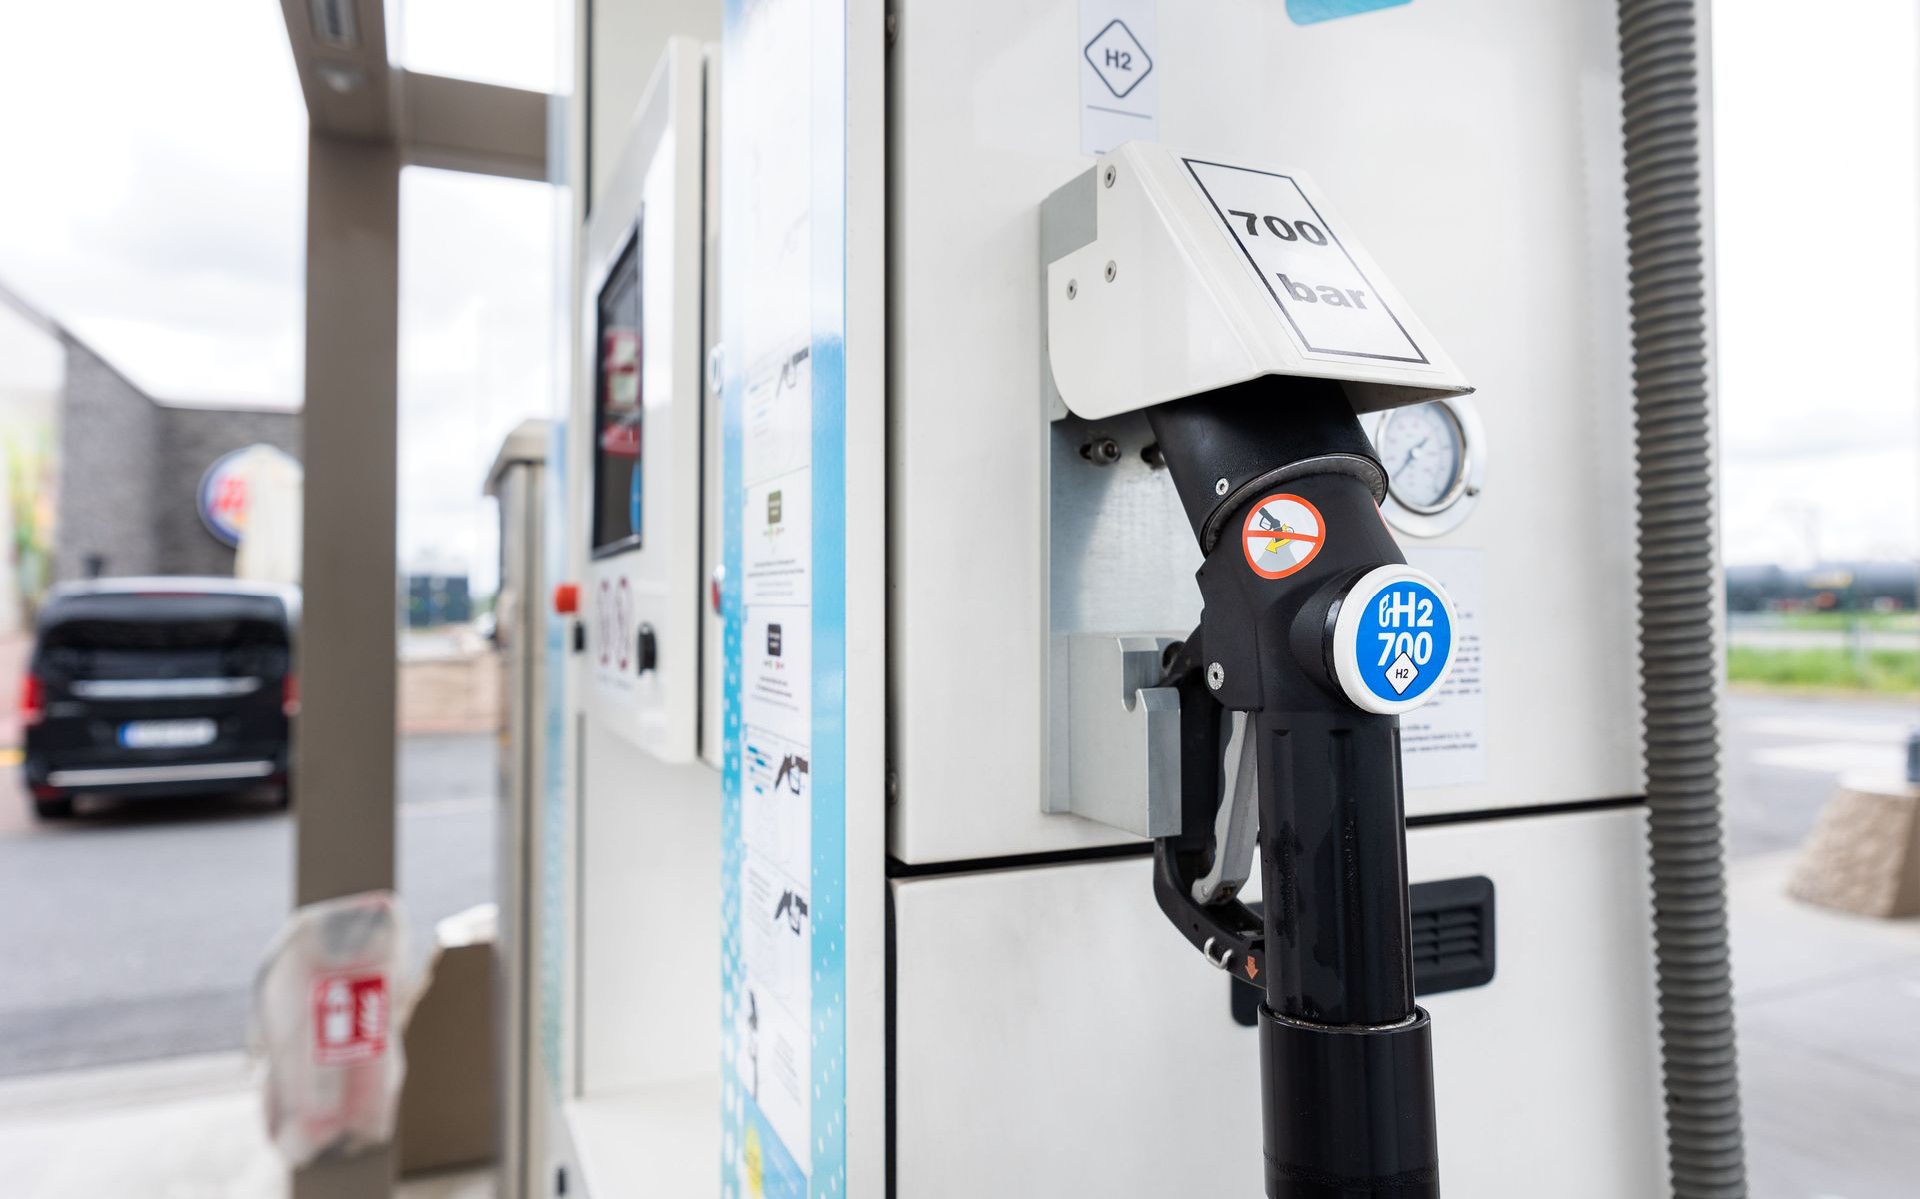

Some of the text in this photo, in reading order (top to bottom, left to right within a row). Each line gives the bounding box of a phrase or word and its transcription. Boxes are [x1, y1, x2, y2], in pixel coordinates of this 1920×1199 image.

[1104, 48, 1132, 71] H2
[1228, 209, 1328, 247] 700
[1276, 272, 1368, 310] bar
[1391, 591, 1433, 628] H2
[1377, 632, 1433, 666] 700
[1395, 668, 1409, 679] H2
